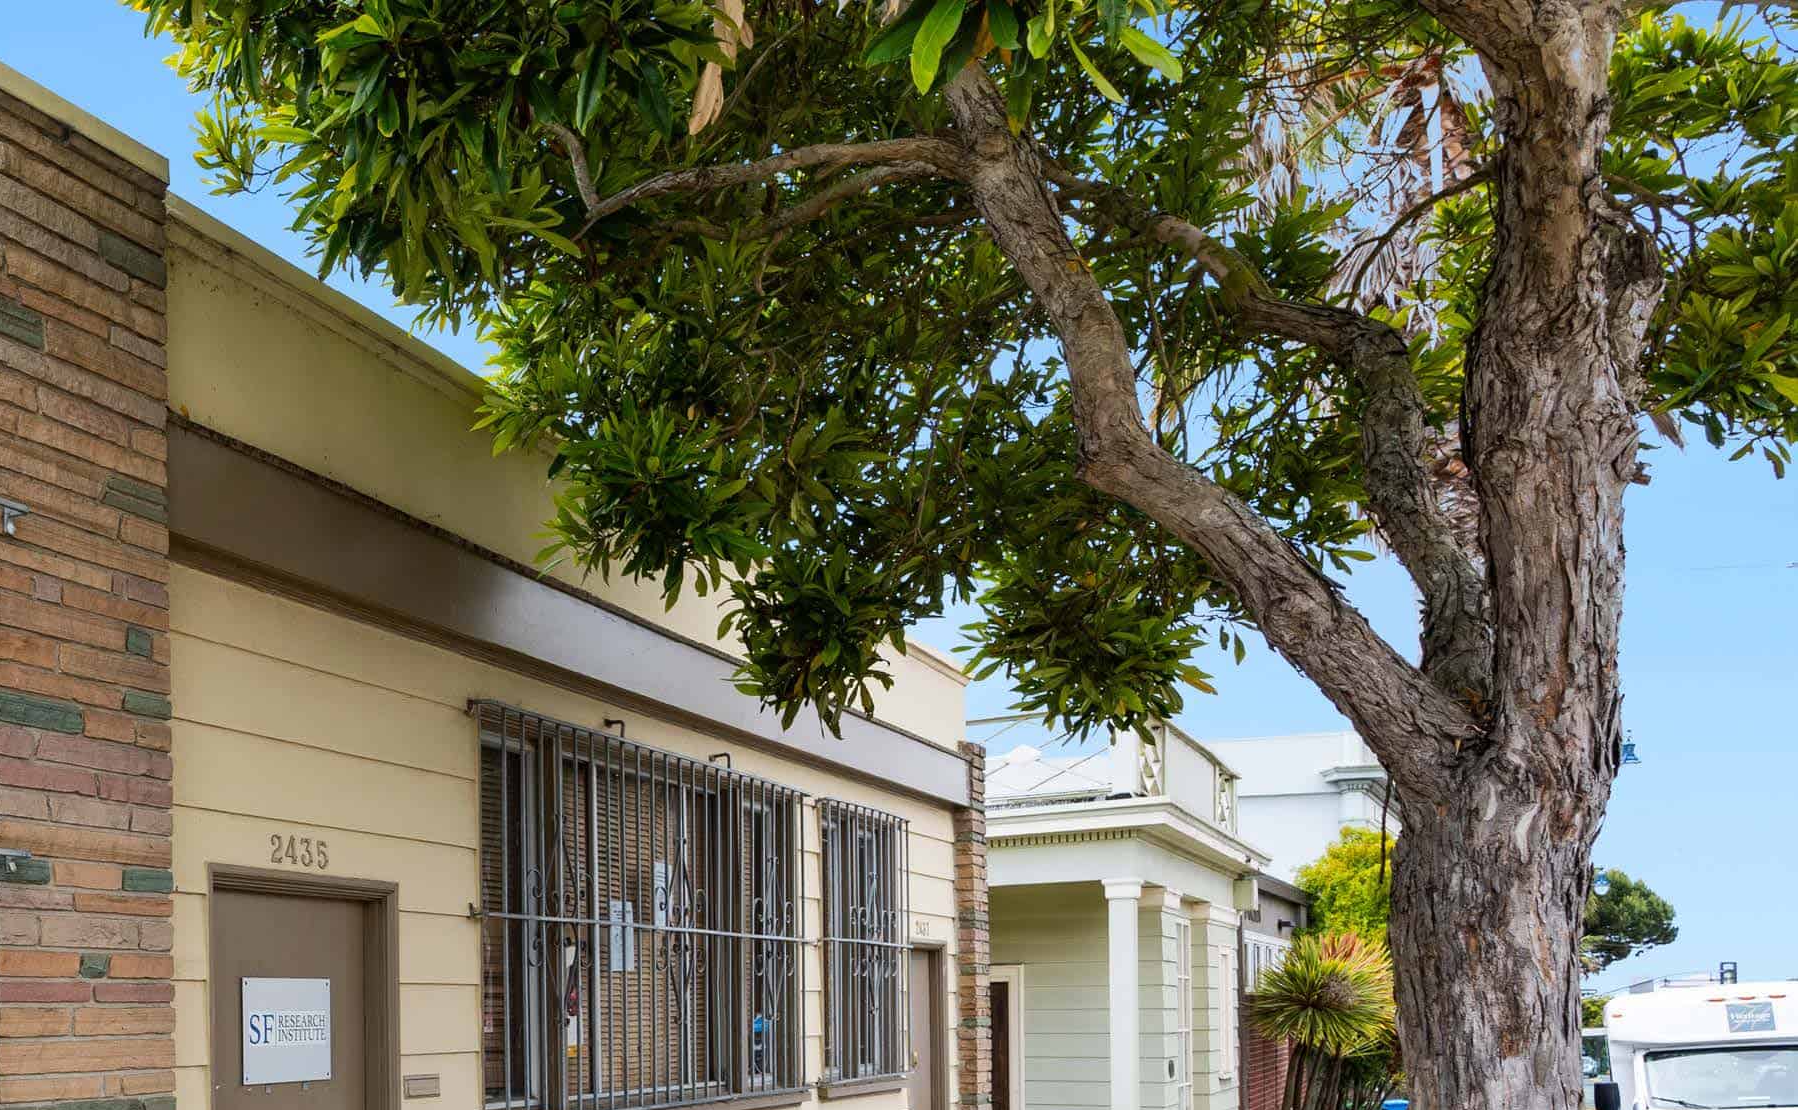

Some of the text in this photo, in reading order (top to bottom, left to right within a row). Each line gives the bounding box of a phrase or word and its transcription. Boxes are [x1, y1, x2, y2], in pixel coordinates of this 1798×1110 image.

[270, 833, 330, 870] 2435
[250, 1014, 275, 1045] SF
[278, 1014, 326, 1028] RESEARCH
[277, 1028, 327, 1042] INSTITUTE
